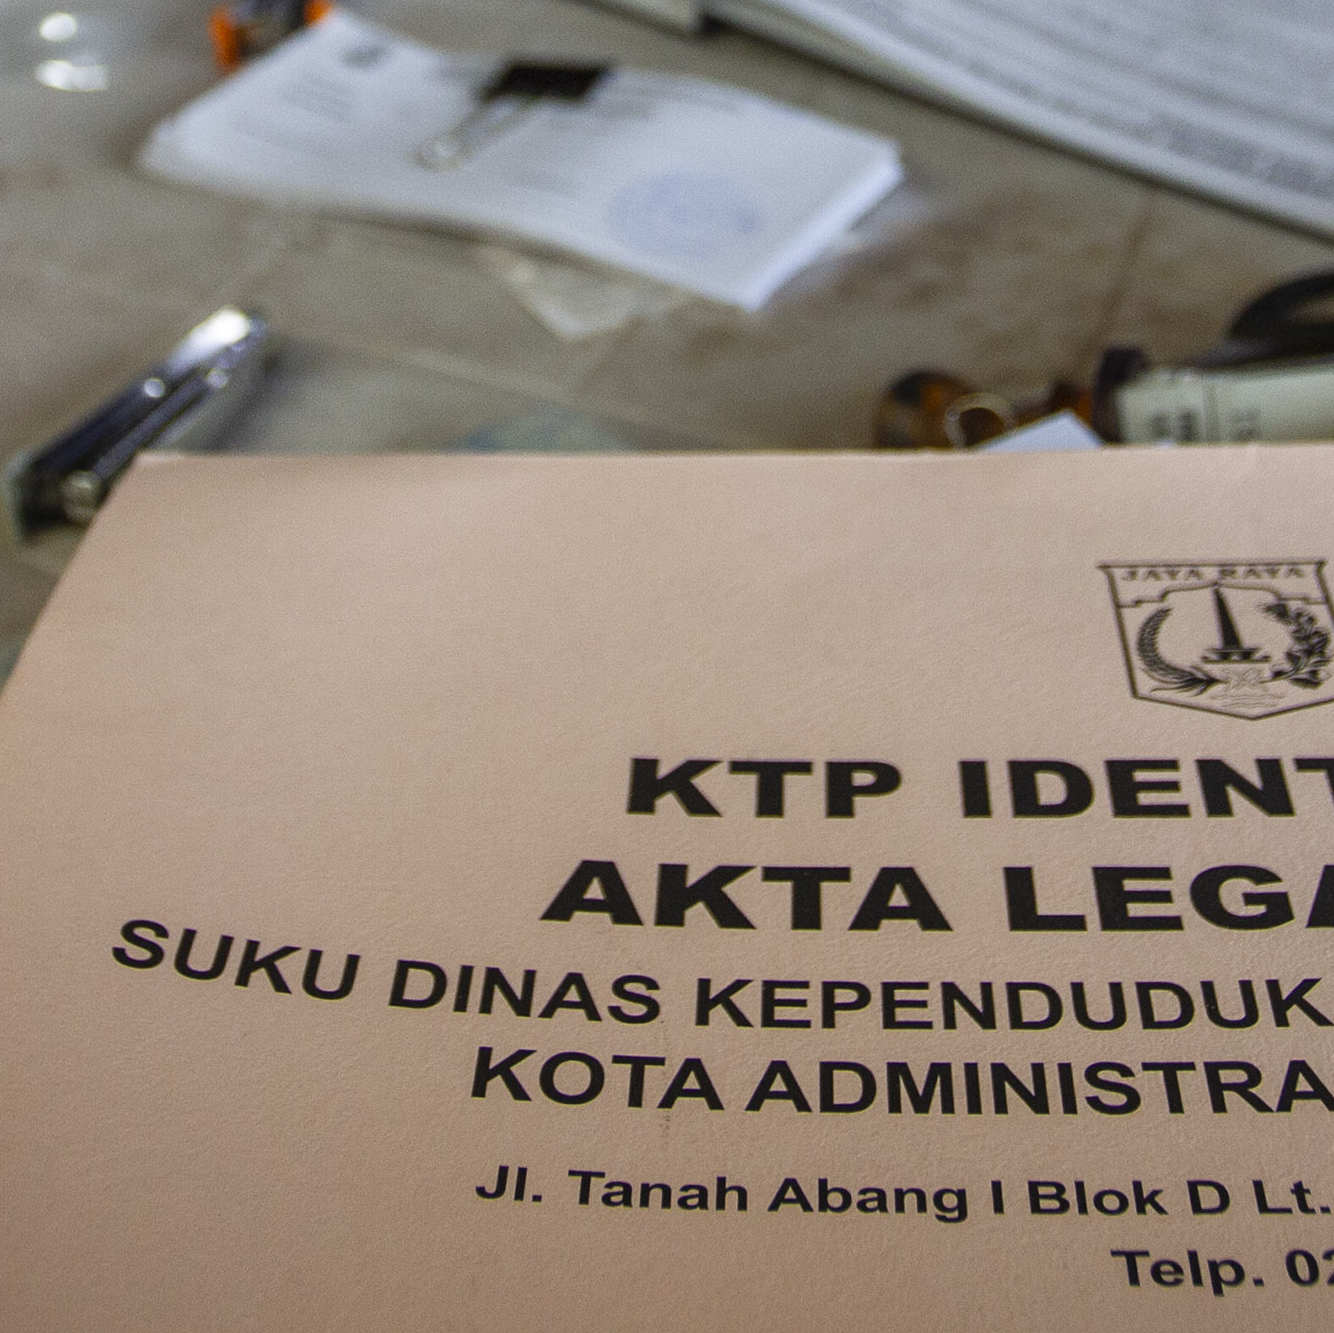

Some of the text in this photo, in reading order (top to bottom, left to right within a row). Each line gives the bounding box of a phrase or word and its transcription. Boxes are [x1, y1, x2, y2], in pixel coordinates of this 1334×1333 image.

[626, 757, 903, 819] KTP
[540, 859, 953, 932] AKTA
[111, 919, 361, 1001] SUKU
[388, 959, 661, 1025] DINAS
[471, 1046, 725, 1111] KOTA
[475, 1165, 543, 1202] Jl.
[567, 1169, 748, 1212] Tanah
[767, 1177, 968, 1224] Abang
[991, 1180, 1005, 1215] I
[1027, 1180, 1167, 1216] Blok
[1186, 1179, 1231, 1215] D
[1252, 1179, 1333, 1215] Lt.
[1110, 1249, 1264, 1297] Telp.
